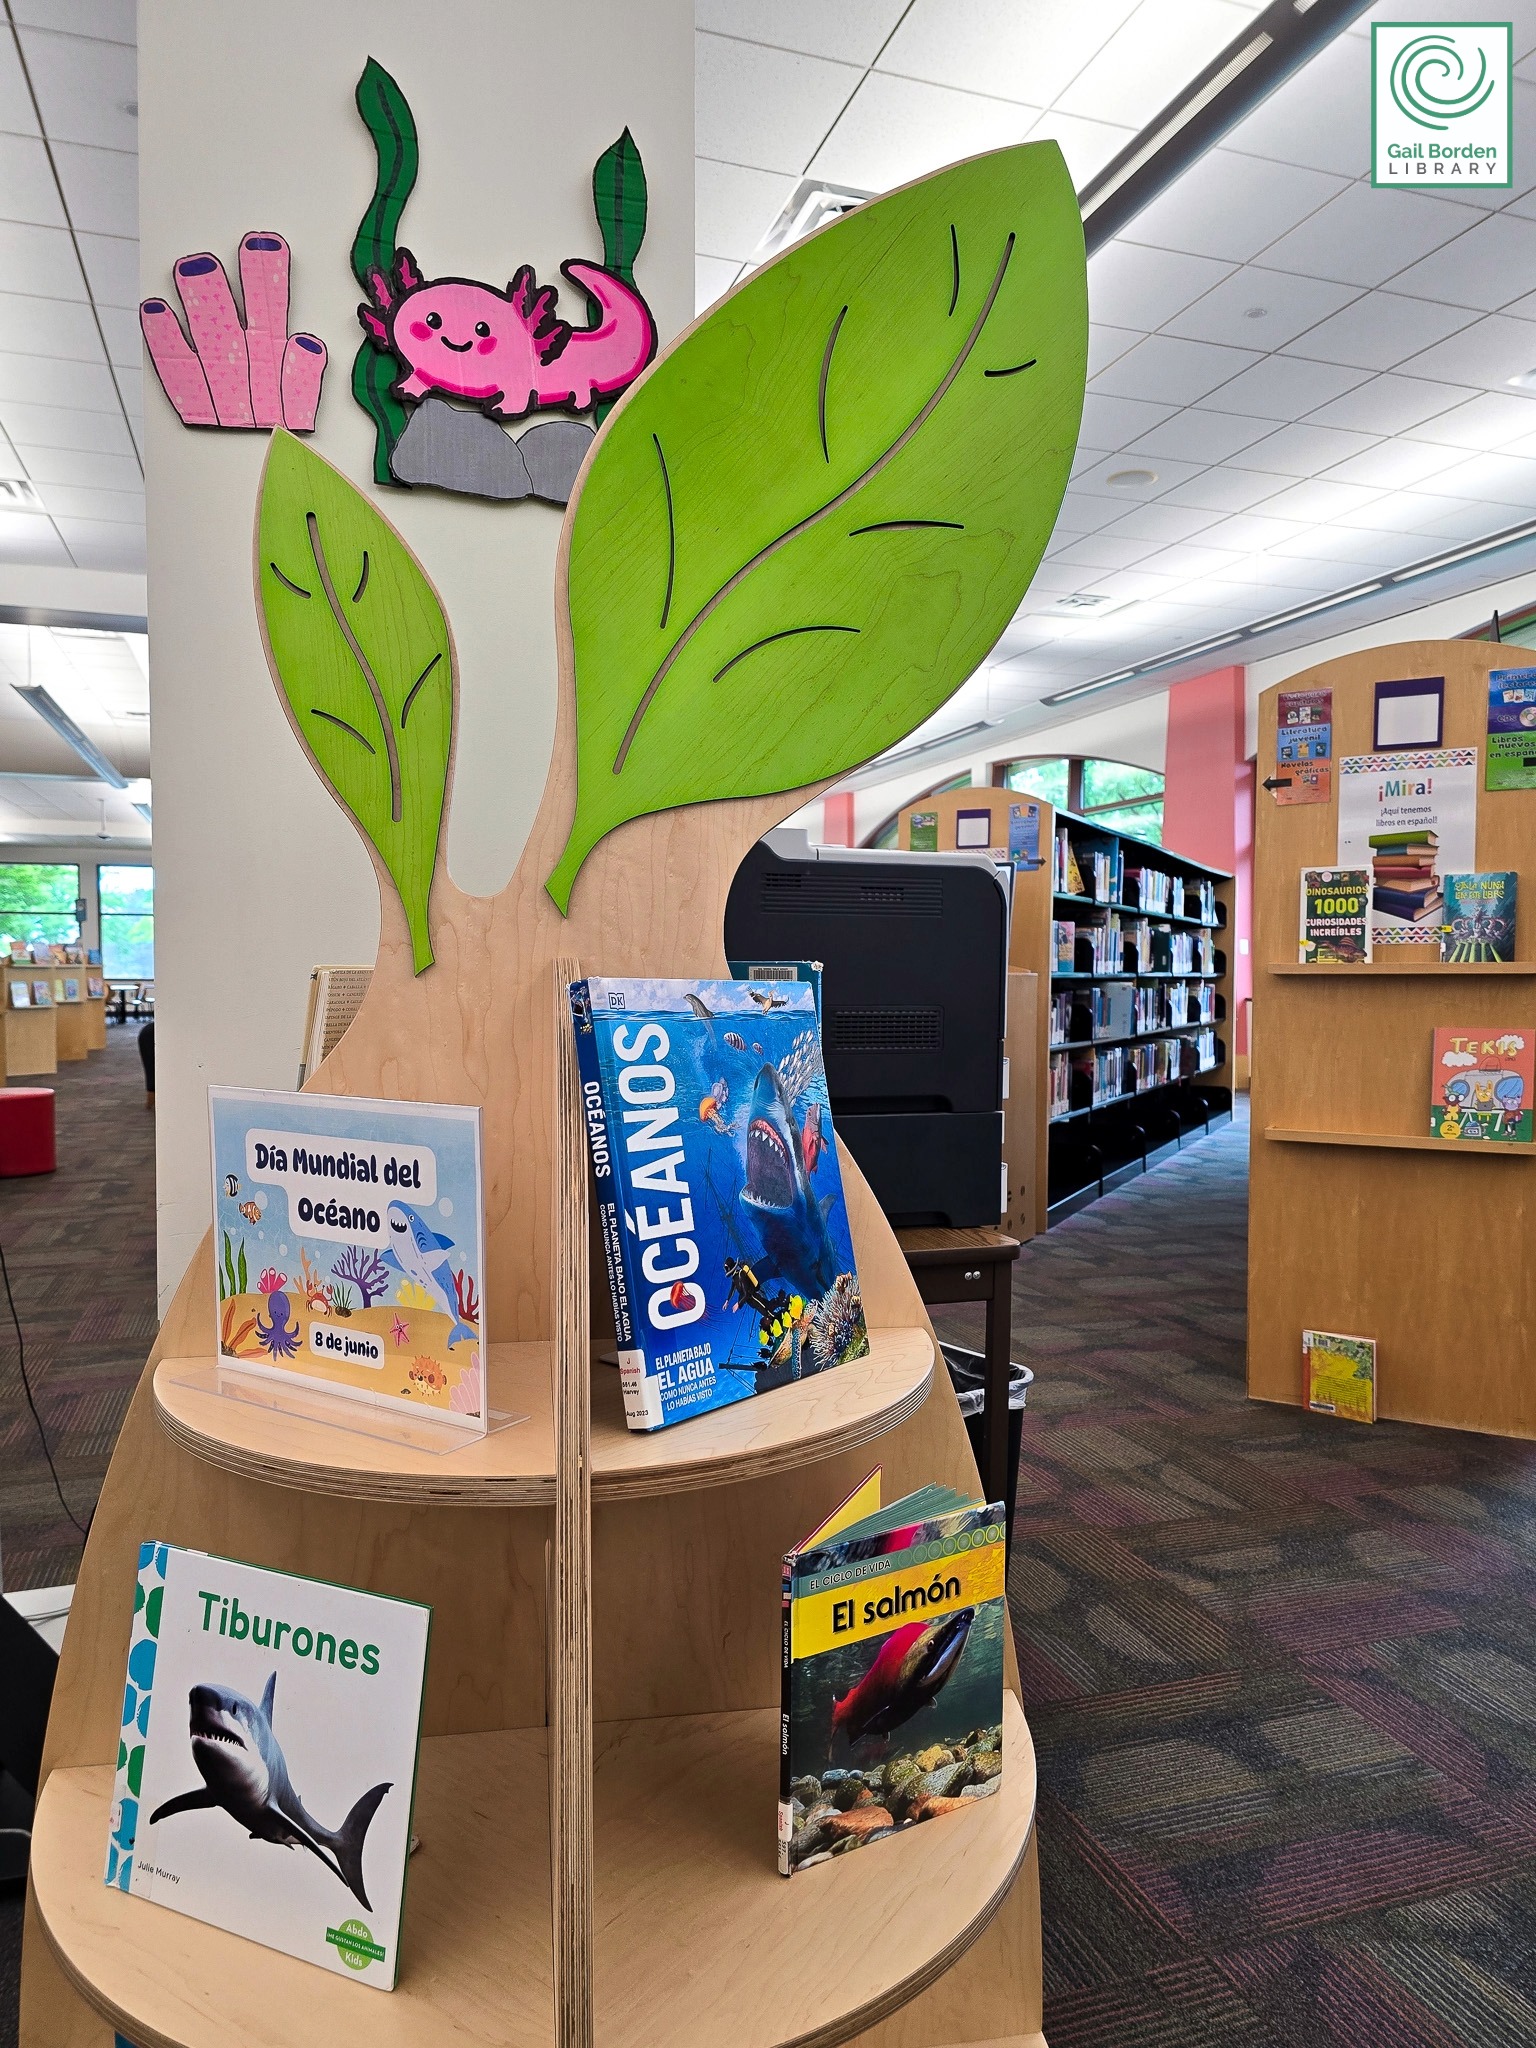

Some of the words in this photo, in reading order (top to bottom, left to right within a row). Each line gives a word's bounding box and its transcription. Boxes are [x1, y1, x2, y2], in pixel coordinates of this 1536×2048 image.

[1281, 726, 1327, 736] Literatura
[1288, 735, 1320, 744] juvenil
[1295, 767, 1329, 776] gráficas
[1378, 778, 1432, 802] ¡Mira!
[1381, 807, 1399, 817] ¡Aquí
[1407, 816, 1437, 826] español!
[1306, 886, 1369, 896] DINOSAURIOS
[1315, 897, 1359, 914] 1000
[1306, 918, 1367, 926] CURIOSIDADES
[1310, 927, 1362, 936] INCREÍBLES
[611, 997, 623, 1005] DK
[584, 1081, 611, 1178] OCÉANOS
[255, 1143, 288, 1172] Día
[293, 1149, 378, 1184] Mundial
[384, 1159, 421, 1188] del
[612, 1023, 706, 1330] OCÉANOS
[298, 1198, 380, 1233] Océano
[608, 1202, 615, 1216] EL
[610, 1218, 621, 1265] PLANETA
[606, 1257, 614, 1280] ANTES
[610, 1280, 616, 1292] LO
[616, 1265, 625, 1294] BAJO
[620, 1297, 628, 1309] EL
[622, 1310, 631, 1341] AGUA
[315, 1331, 322, 1348] 8
[326, 1334, 342, 1350] de
[344, 1338, 379, 1359] junio
[656, 1357, 664, 1370] EL
[664, 1348, 695, 1367] PLANETA
[694, 1343, 711, 1357] BAJO
[620, 1367, 640, 1375] Spanish
[658, 1370, 675, 1390] EL
[679, 1358, 714, 1384] AGUA
[660, 1390, 678, 1402] COMO
[678, 1382, 698, 1397] NUNCA
[698, 1376, 716, 1390] ANTES
[667, 1402, 675, 1411] LO
[676, 1393, 696, 1408] HABÍAS
[696, 1388, 712, 1402] VISTO
[810, 1580, 819, 1590] EL
[823, 1571, 852, 1586] CICLO
[855, 1565, 867, 1577] DE
[868, 1559, 891, 1573] VIDA
[832, 1599, 854, 1633] El
[863, 1573, 960, 1624] salmón
[198, 1590, 381, 1675] Tiburones
[783, 1714, 789, 1722] El
[138, 1861, 154, 1873] Julie
[156, 1867, 180, 1884] Murray
[346, 1924, 367, 1938] Abdo
[346, 1952, 362, 1966] Kids
